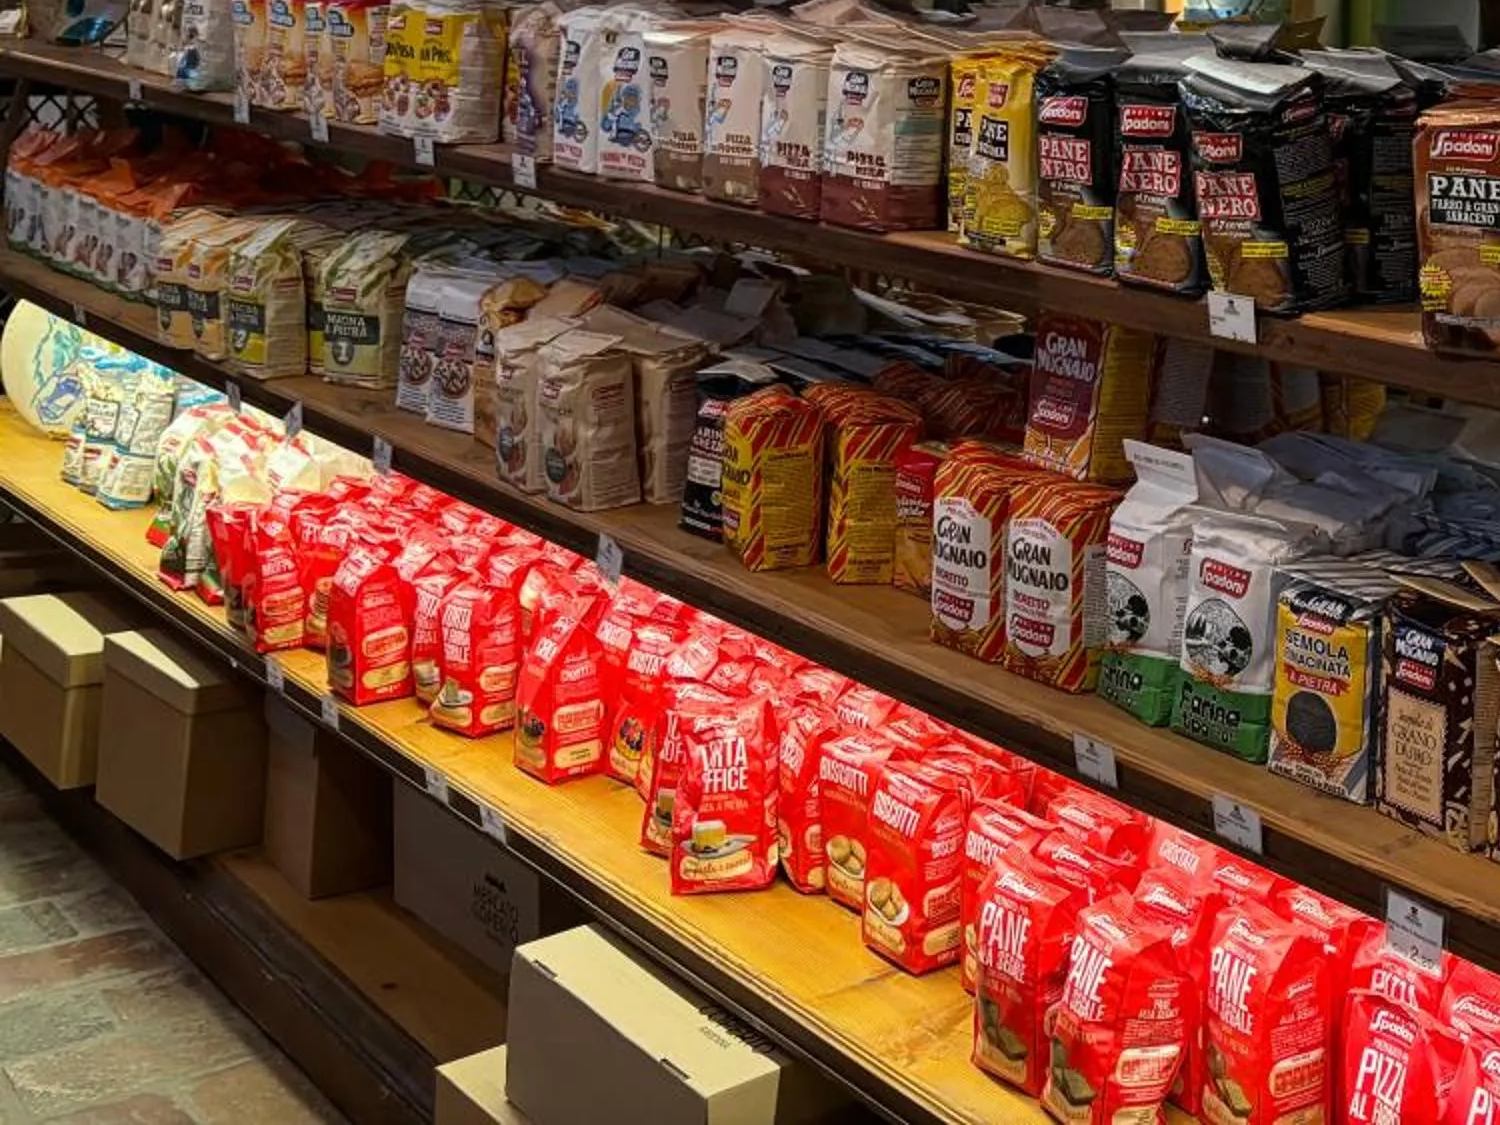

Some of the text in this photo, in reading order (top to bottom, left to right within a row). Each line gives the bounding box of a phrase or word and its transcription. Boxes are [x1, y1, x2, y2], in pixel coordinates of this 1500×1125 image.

[1040, 138, 1088, 162] PANE
[1430, 132, 1493, 157] Spadoni
[1040, 161, 1088, 180] NERO
[1122, 173, 1177, 194] NERO
[1198, 176, 1255, 198] PANE
[1199, 197, 1256, 217] NERO
[1445, 211, 1495, 225] SARACENO
[1045, 331, 1089, 357] GRAN
[937, 516, 971, 544] GRAN
[1013, 536, 1051, 566] GRAN
[1285, 628, 1349, 662] SEMOLA
[1299, 673, 1338, 694] PIETRA
[980, 901, 1032, 962] PANE
[1070, 934, 1113, 1003] PANE
[1211, 947, 1257, 1012] PANE
